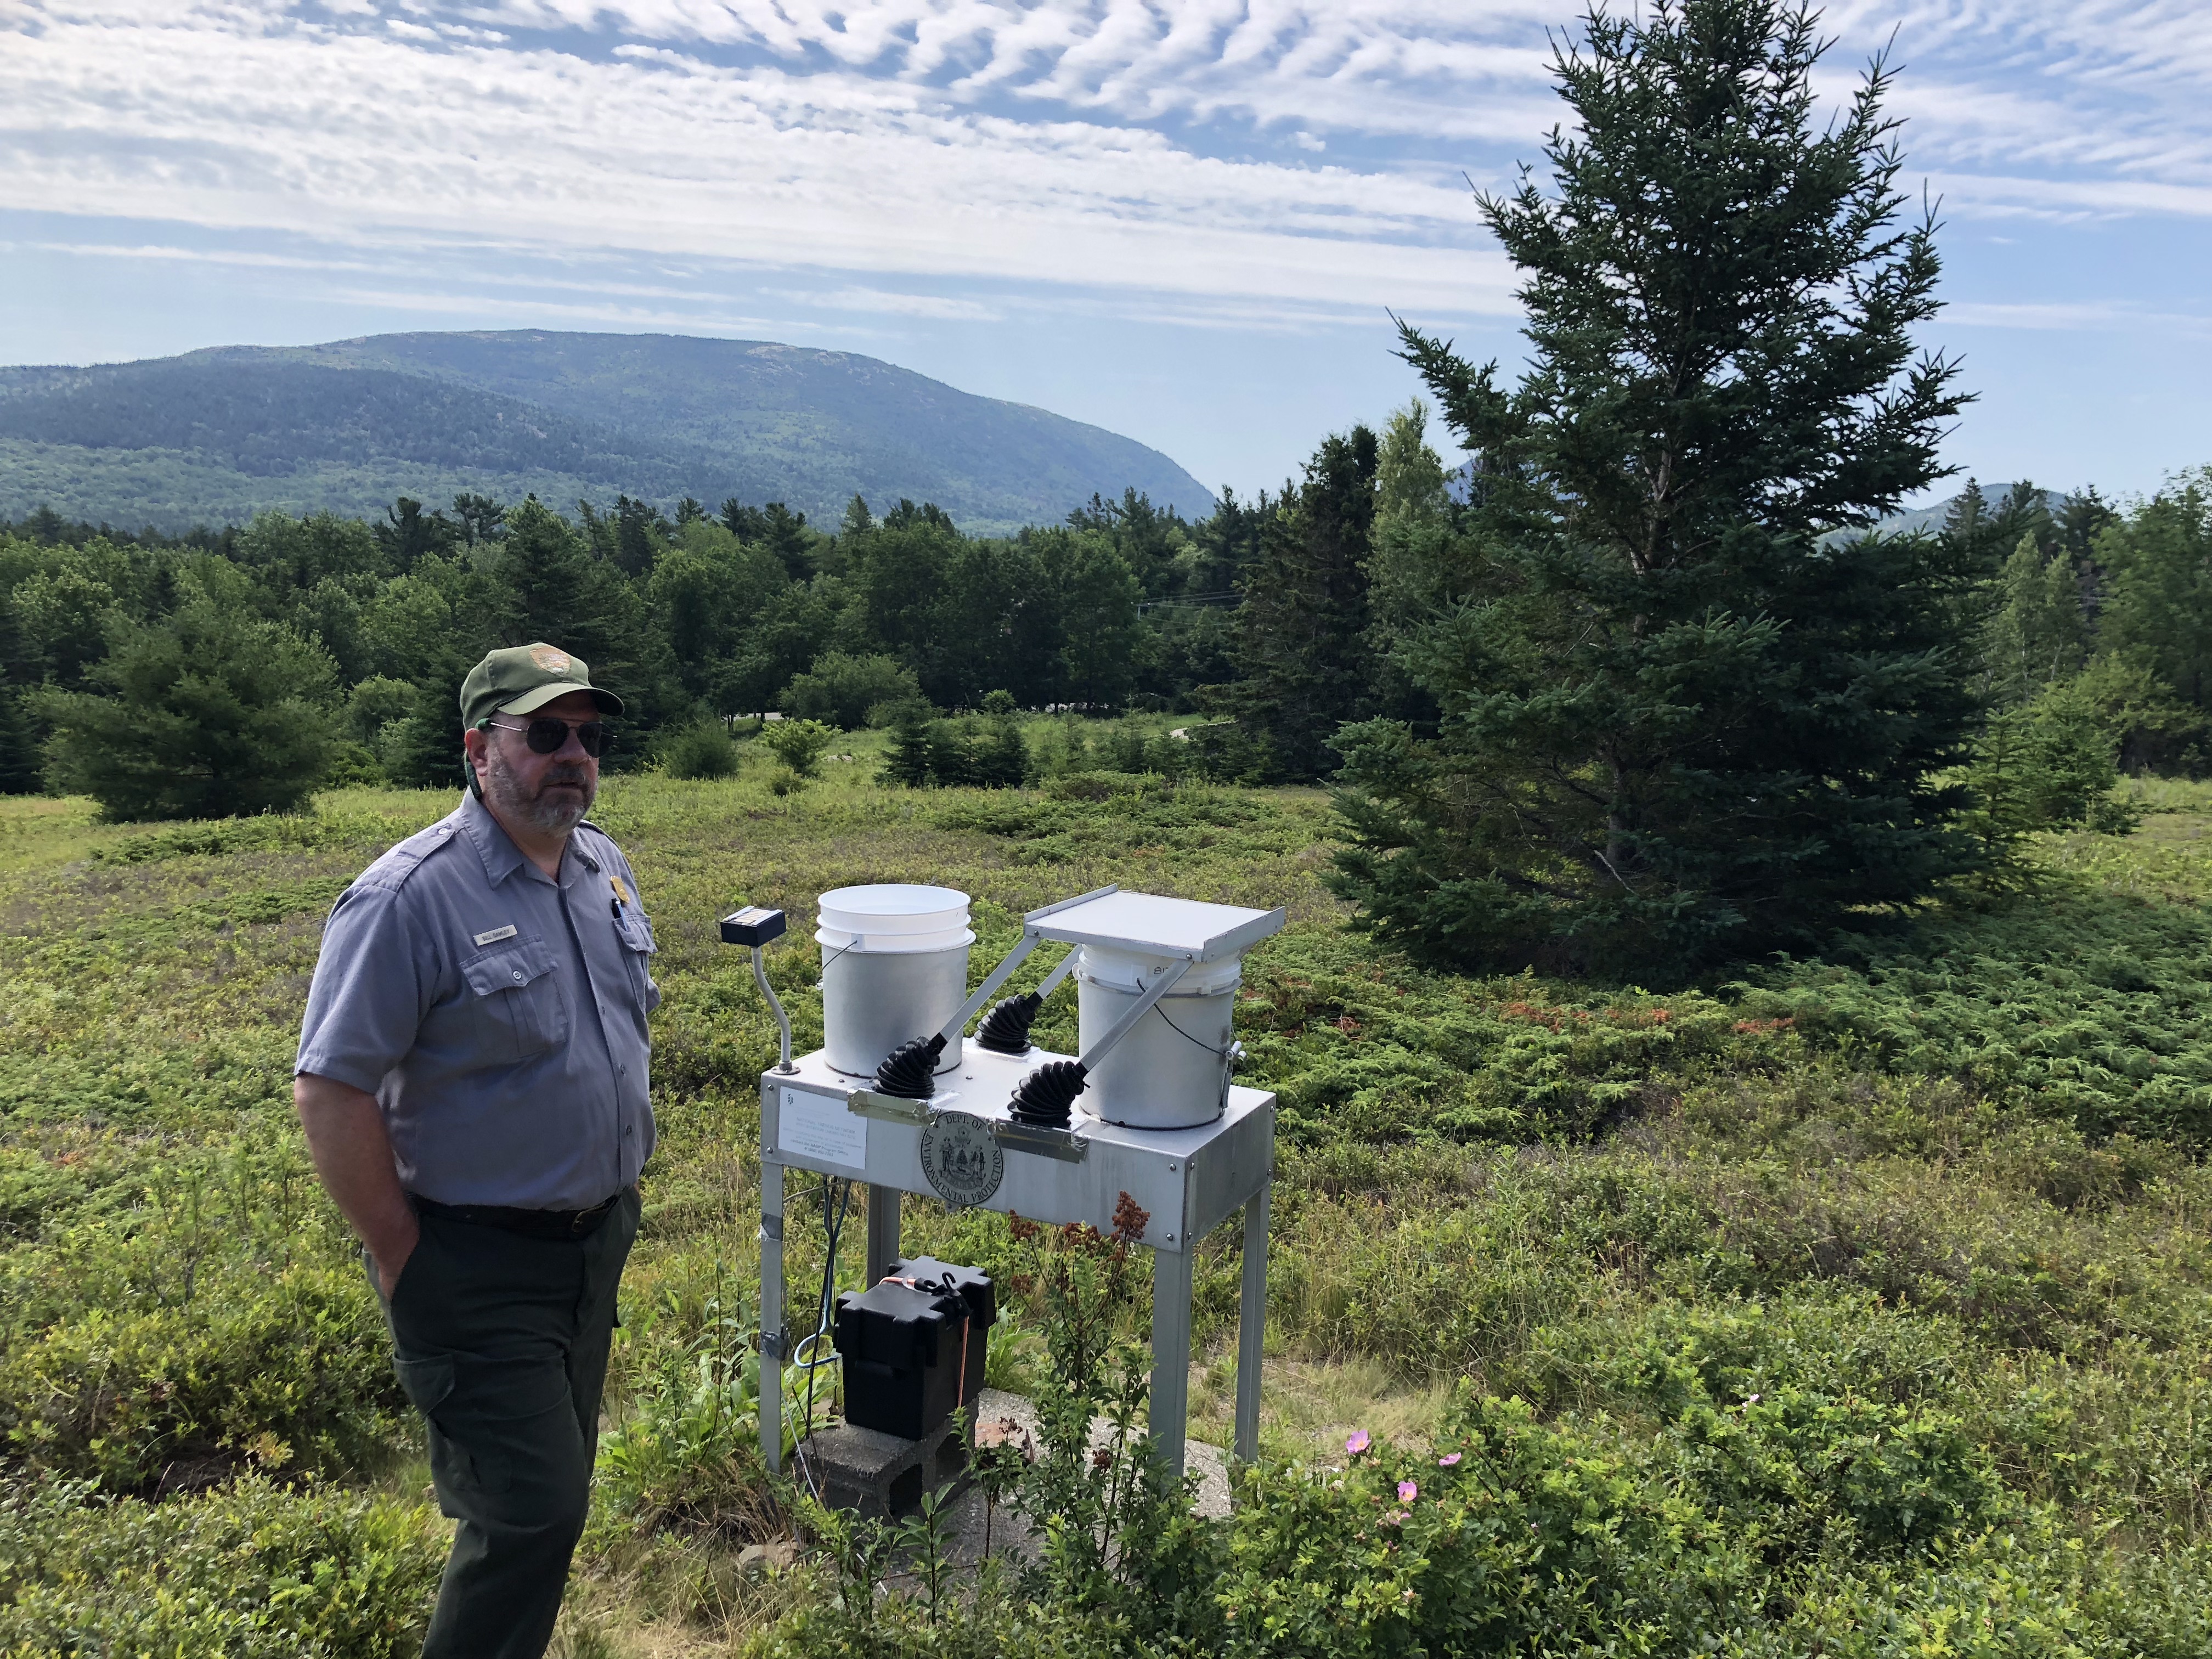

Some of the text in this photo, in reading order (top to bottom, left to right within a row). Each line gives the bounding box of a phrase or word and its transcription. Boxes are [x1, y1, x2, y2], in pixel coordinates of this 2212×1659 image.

[945, 1114, 984, 1131] DEPT. OF
[923, 1133, 1001, 1203] ENVIRONMENTAL PROTECTION
